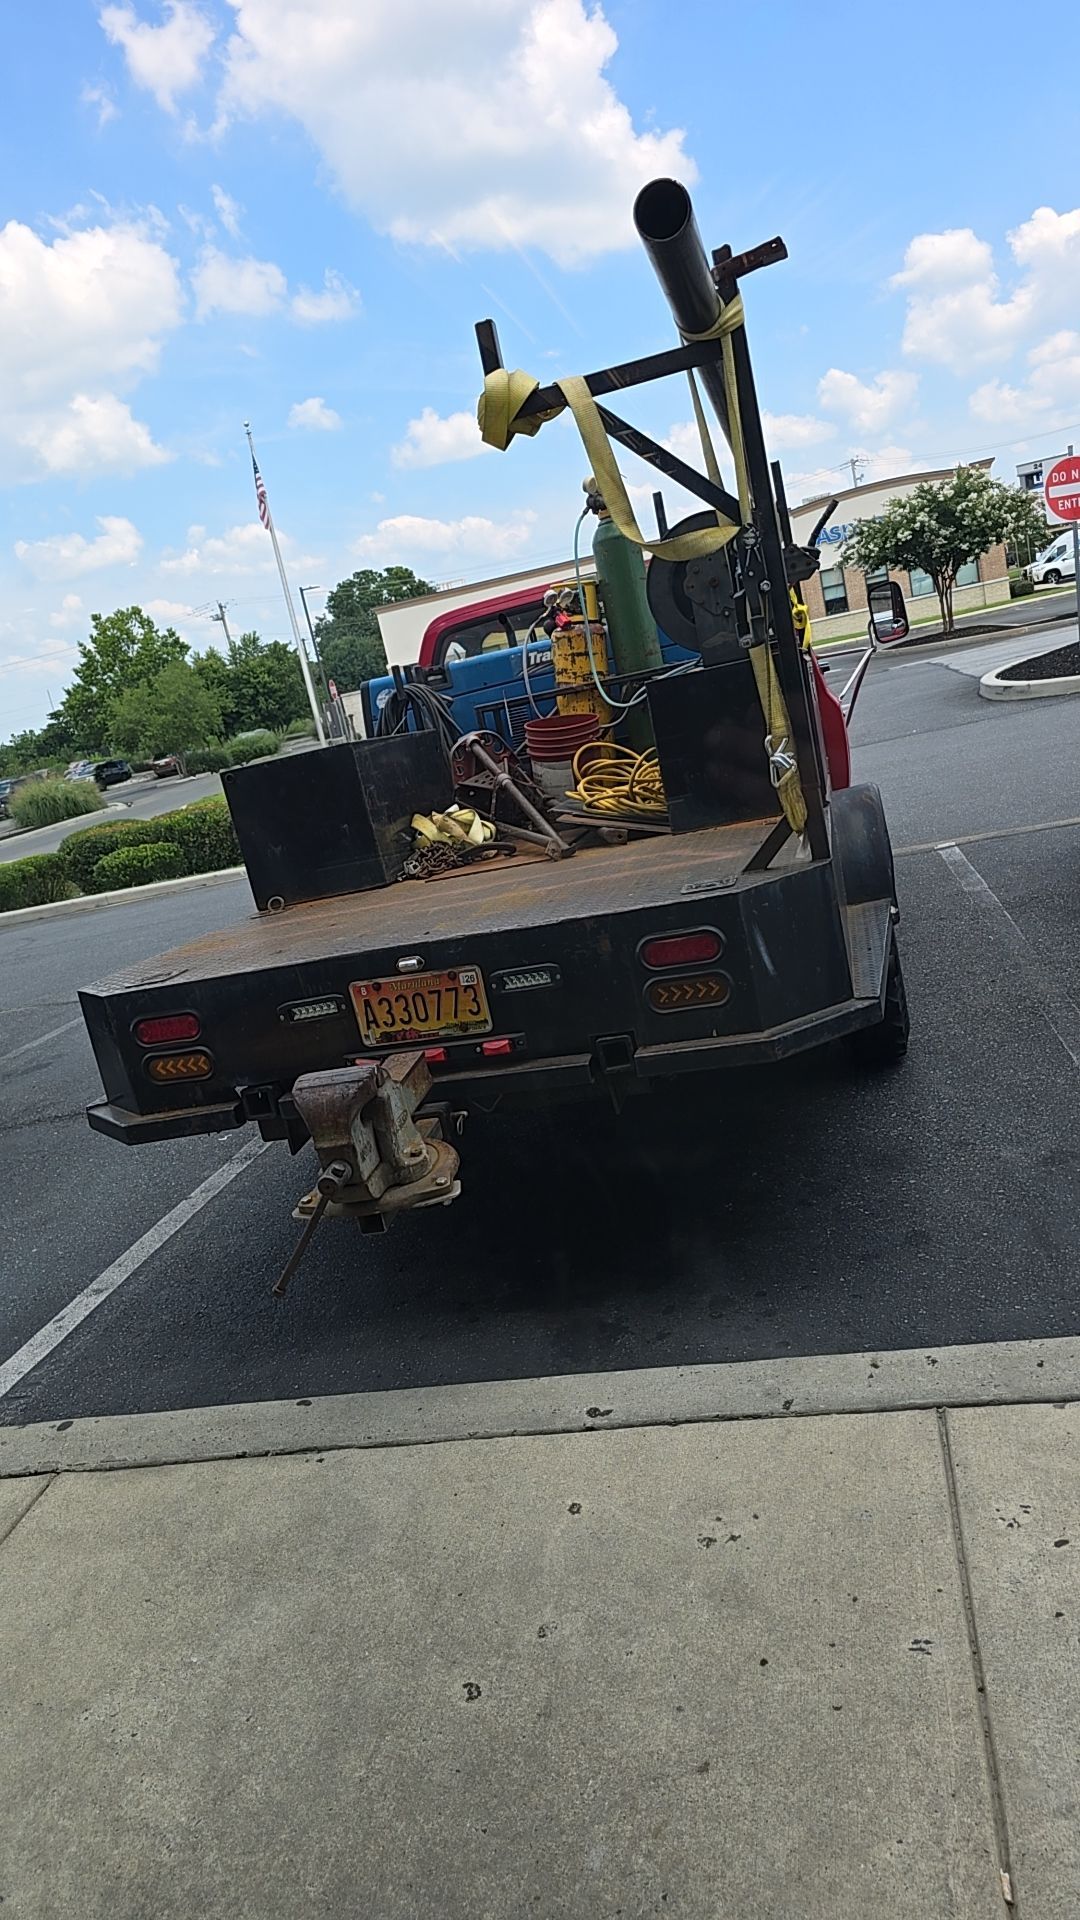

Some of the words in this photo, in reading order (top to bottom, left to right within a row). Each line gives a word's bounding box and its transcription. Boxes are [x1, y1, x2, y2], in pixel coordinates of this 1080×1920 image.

[1052, 471, 1066, 483] DO
[389, 977, 441, 992] Maryland
[363, 985, 481, 1030] A330773
